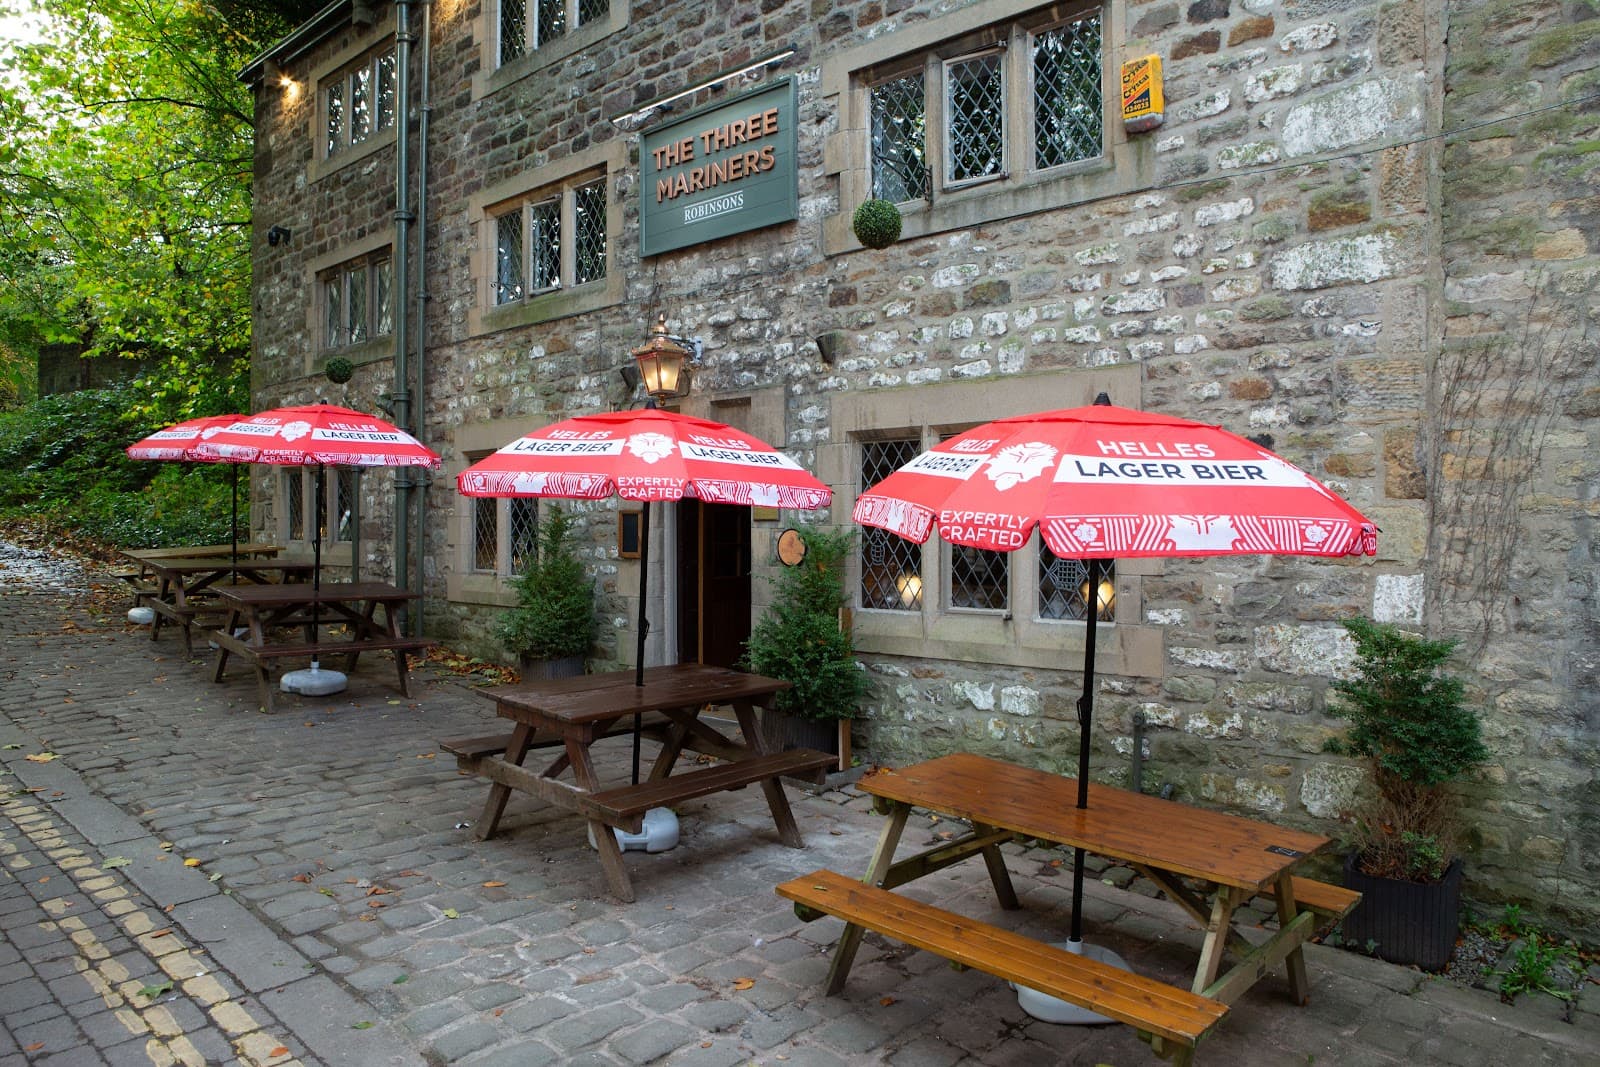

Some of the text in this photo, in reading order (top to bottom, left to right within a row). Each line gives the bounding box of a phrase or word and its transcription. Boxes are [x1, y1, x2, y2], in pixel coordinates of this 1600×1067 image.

[1123, 74, 1150, 99] Crystal
[652, 107, 778, 170] THE THREE
[656, 145, 775, 202] MARINERS
[683, 193, 744, 222] ROBINSONS
[329, 422, 379, 432] HELLES
[547, 430, 613, 440] HELLES
[321, 431, 399, 441] LAGER BIER
[688, 434, 752, 450] HELLES
[514, 441, 614, 452] LAGER BIER
[949, 439, 1000, 452] HELLES
[1096, 440, 1216, 458] HELLES
[688, 445, 784, 465] LAGER BIER
[914, 455, 957, 471] LAGER
[1075, 460, 1269, 481] LAGER BIER
[617, 476, 686, 487] EXPERTLY
[618, 487, 684, 499] CRAFTED
[940, 510, 1030, 530] EXPERTLY
[939, 525, 1024, 547] CRAFTED
